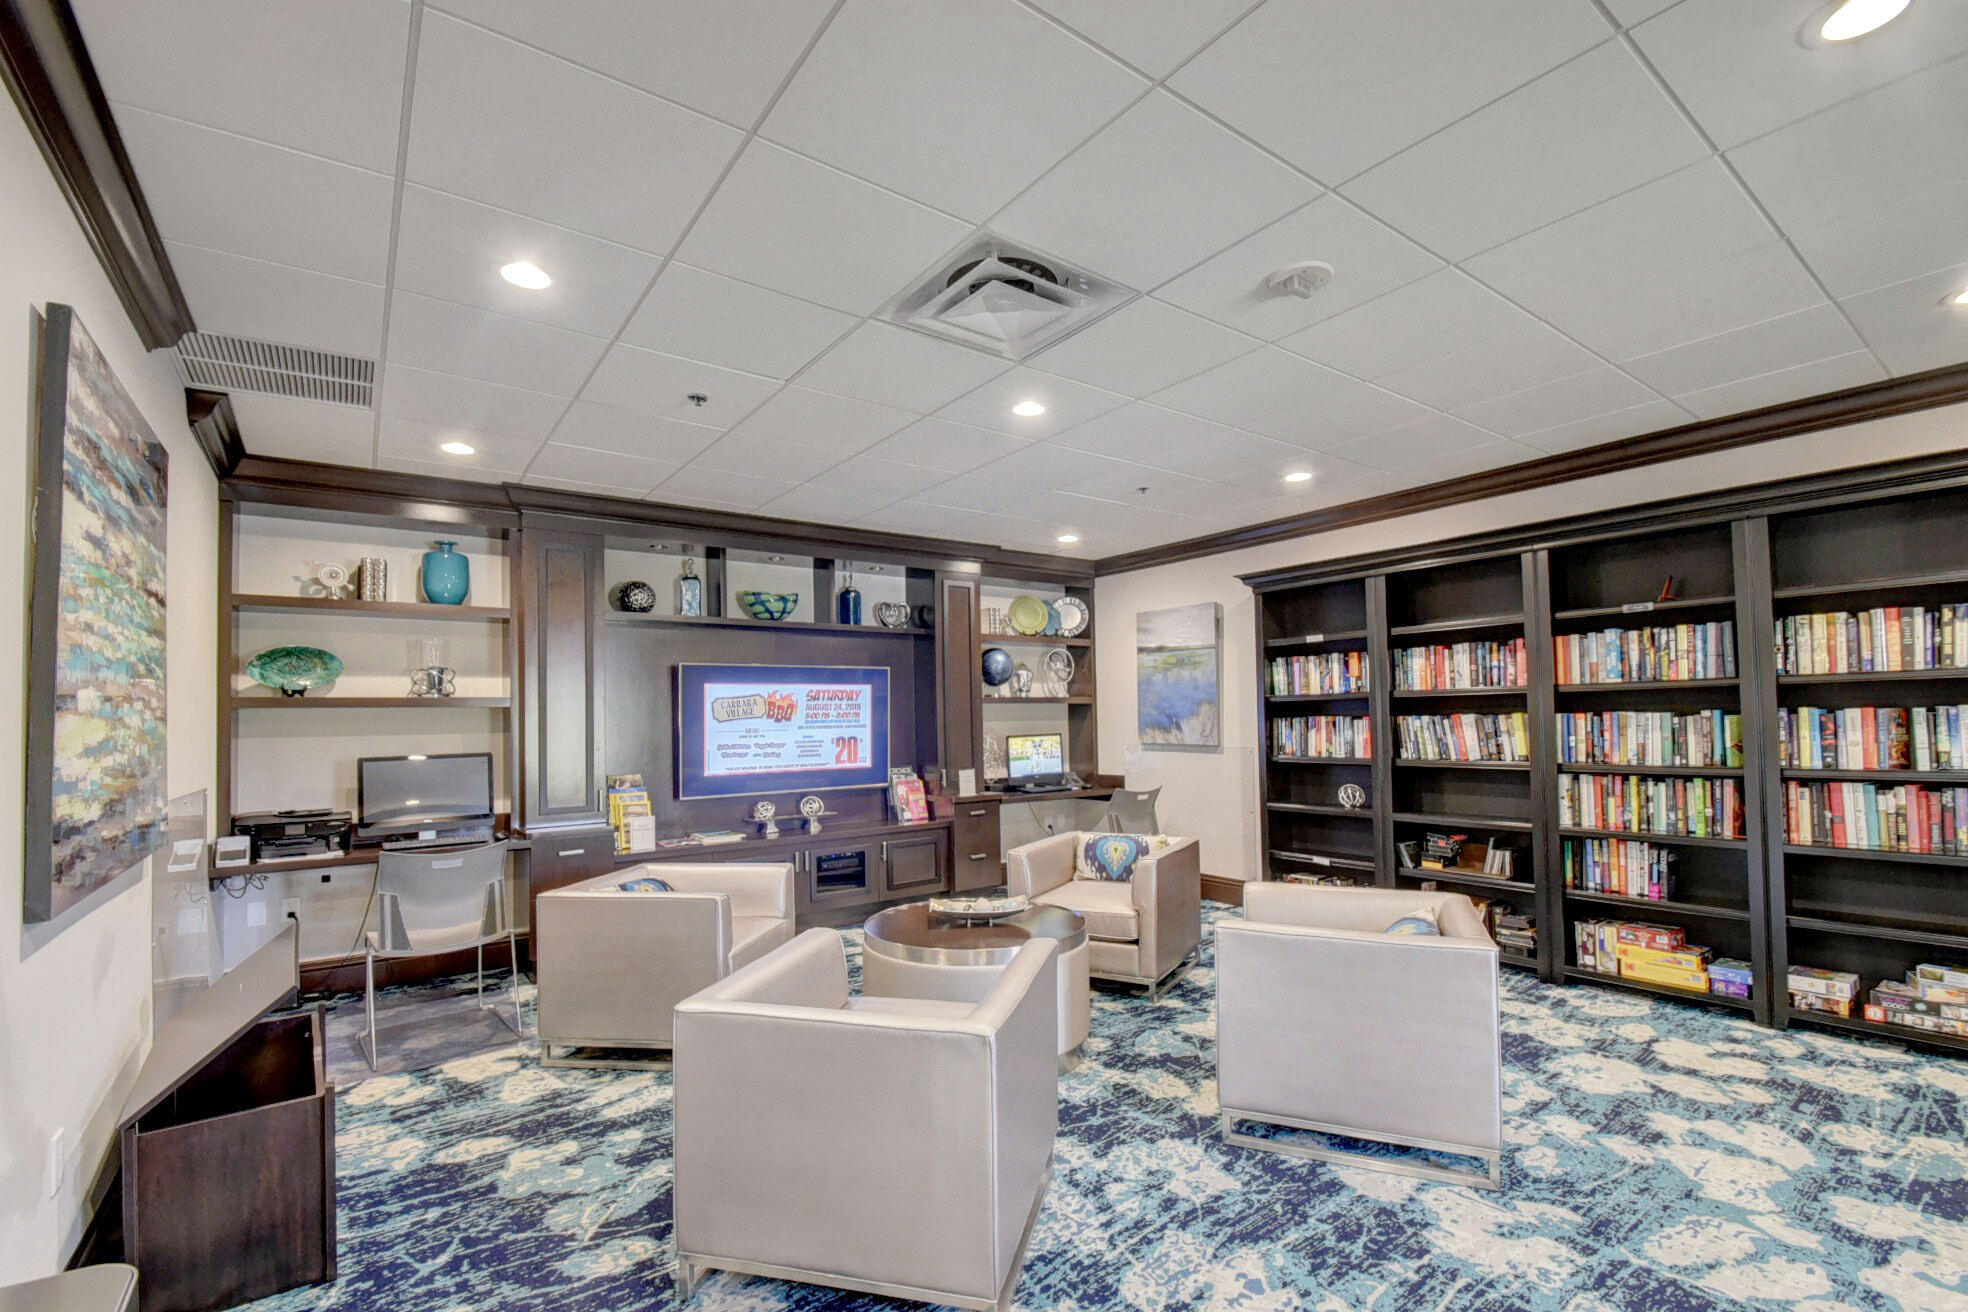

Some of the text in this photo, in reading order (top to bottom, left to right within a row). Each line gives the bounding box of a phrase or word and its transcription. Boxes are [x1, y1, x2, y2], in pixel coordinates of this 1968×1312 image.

[805, 689, 863, 702] SATURDAY
[720, 698, 758, 710] CARRARA
[805, 703, 832, 711] AUGUST
[726, 707, 756, 719] VILLAGE
[767, 701, 795, 722] BBQ
